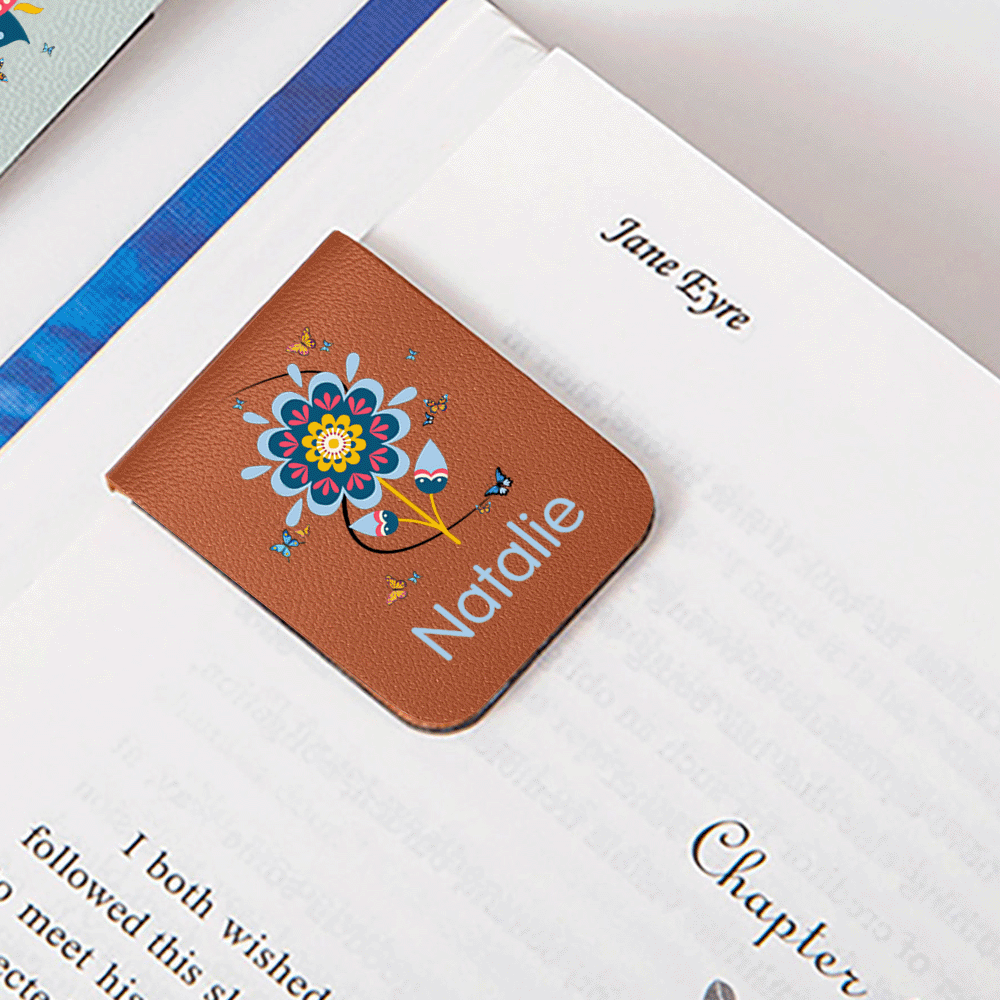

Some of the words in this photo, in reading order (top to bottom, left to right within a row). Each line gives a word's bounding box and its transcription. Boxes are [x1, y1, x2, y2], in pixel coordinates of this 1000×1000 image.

[600, 217, 681, 278] Jane
[675, 268, 751, 332] Eyre
[411, 496, 585, 661] Natalie
[16, 903, 95, 971] meet
[20, 824, 151, 939] followed
[146, 933, 204, 987] this
[121, 831, 148, 858] I
[145, 850, 214, 921] both
[690, 820, 868, 998] Chapter
